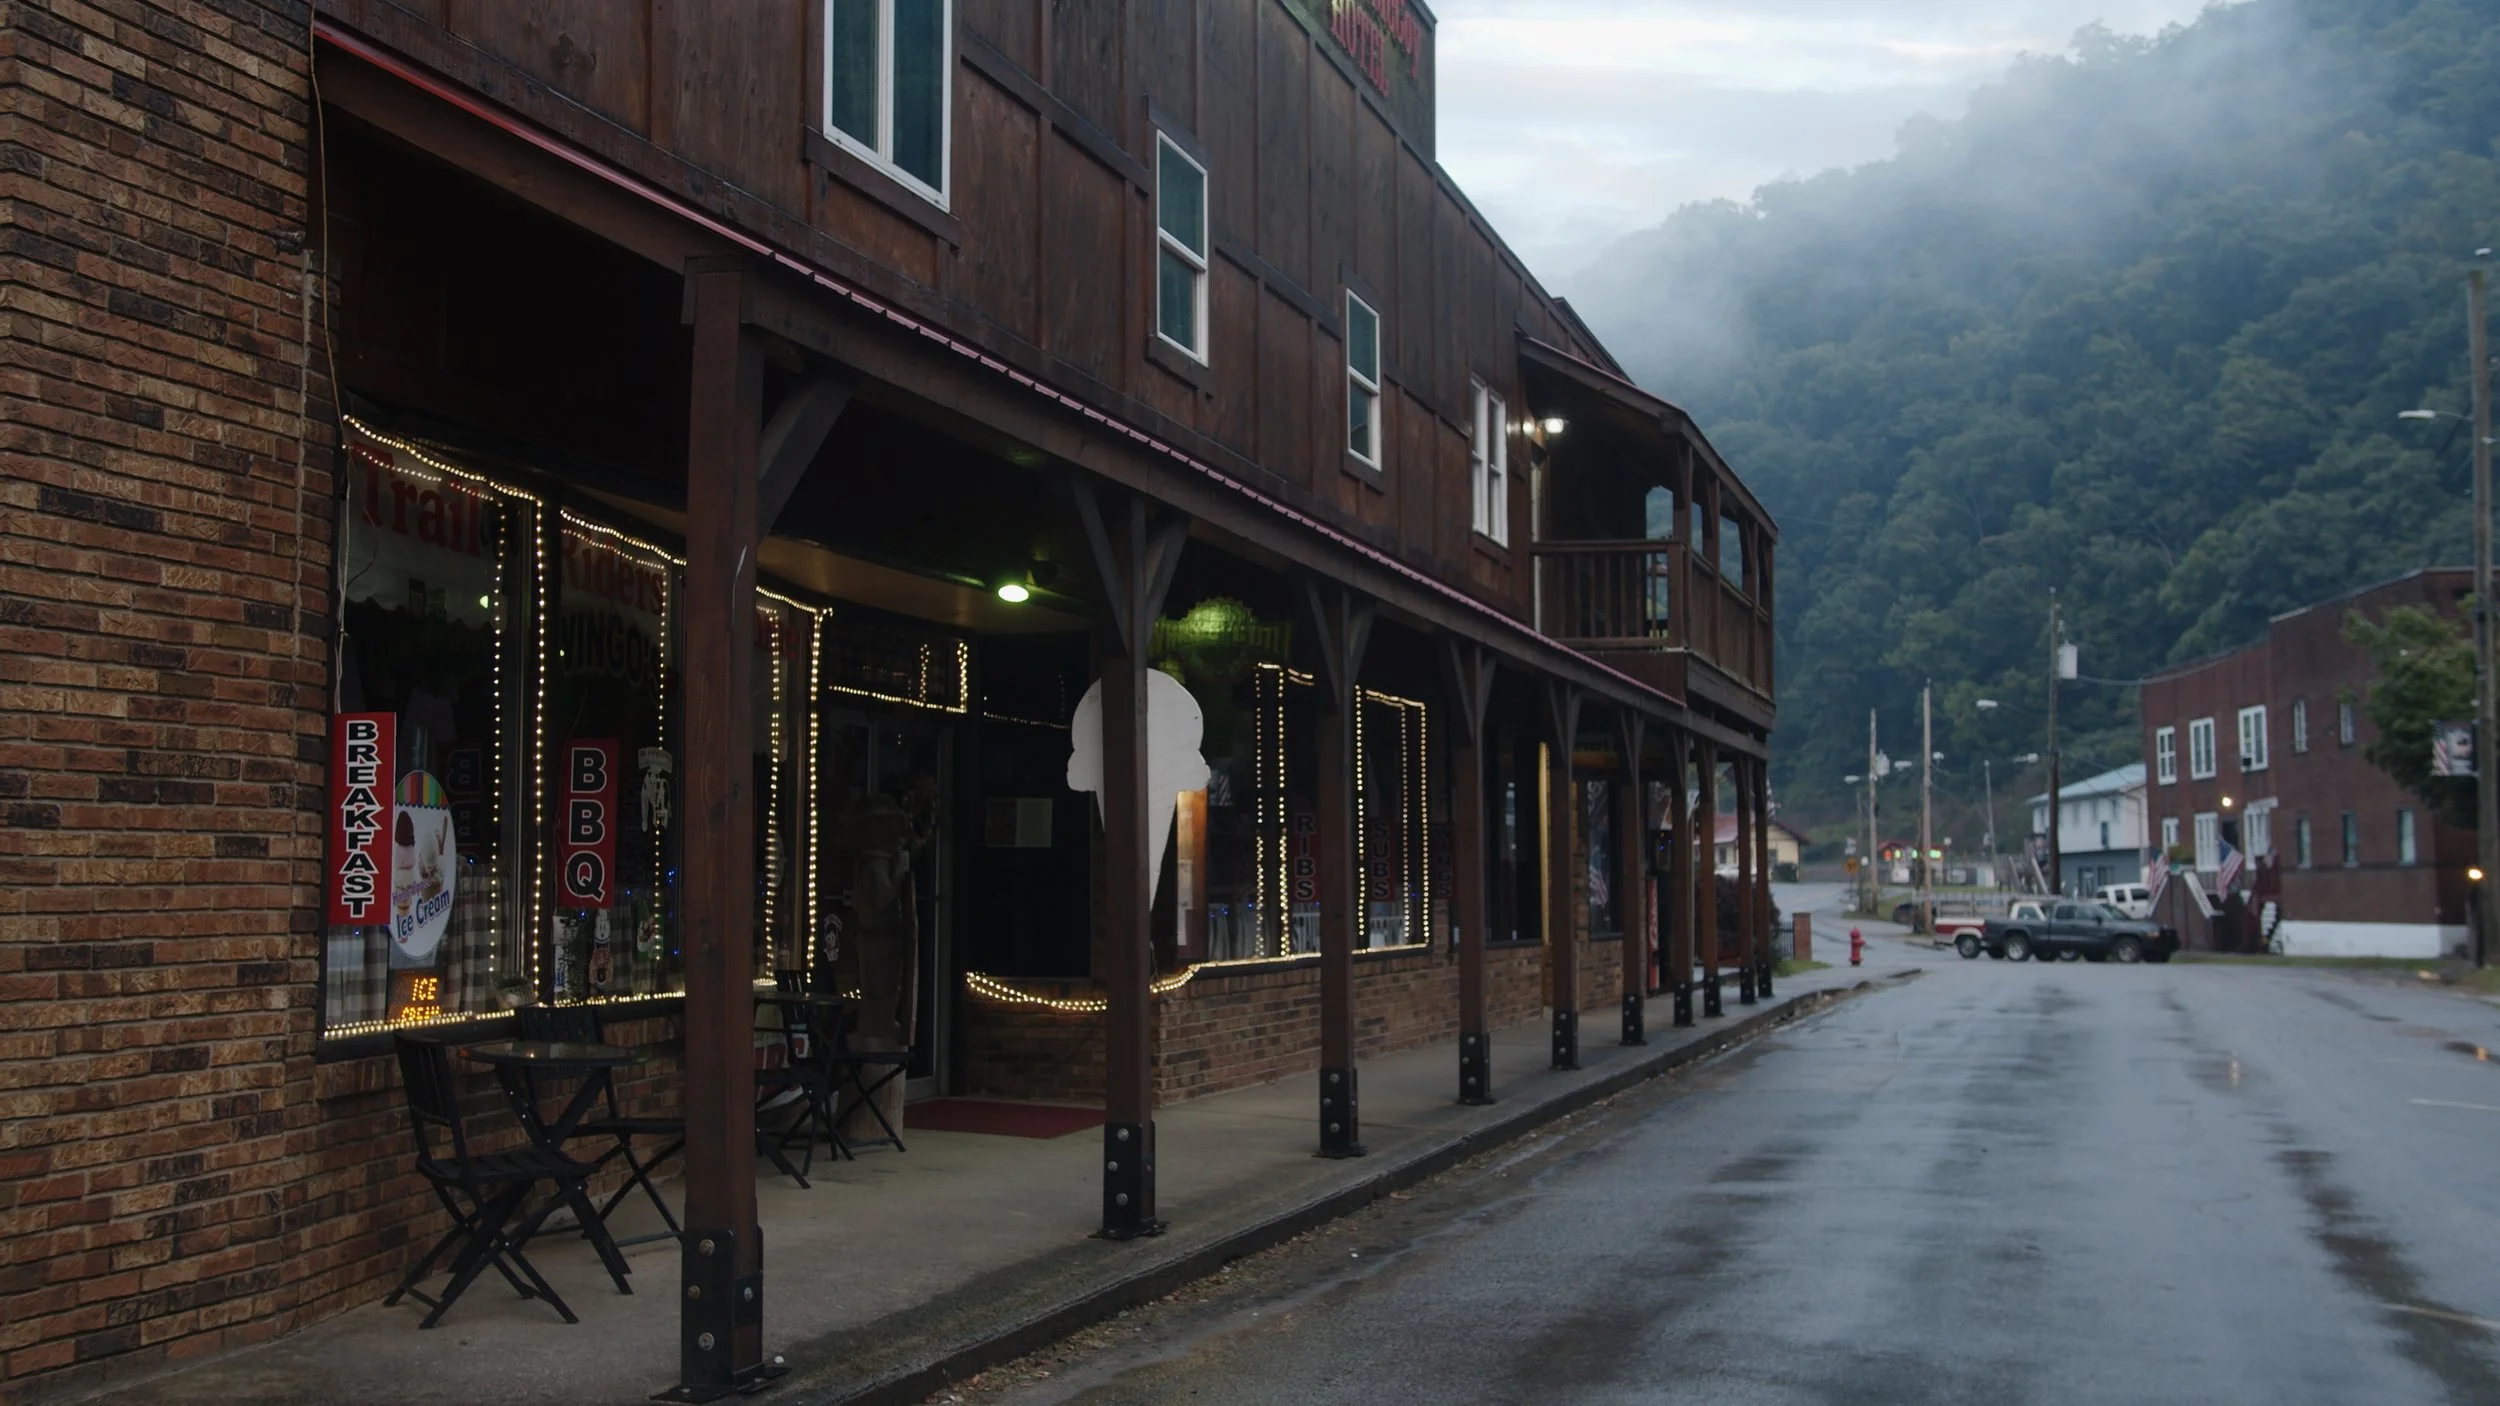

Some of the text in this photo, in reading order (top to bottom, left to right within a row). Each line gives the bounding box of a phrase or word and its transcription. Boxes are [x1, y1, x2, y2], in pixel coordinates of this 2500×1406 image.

[350, 440, 481, 558] Trail
[340, 720, 383, 918] BREAKFAST
[565, 747, 607, 902] BBQ
[1294, 812, 1318, 901] RIBS
[1370, 820, 1391, 900] SUBS
[397, 889, 450, 939] Ice Cream
[412, 978, 437, 1001] ICE
